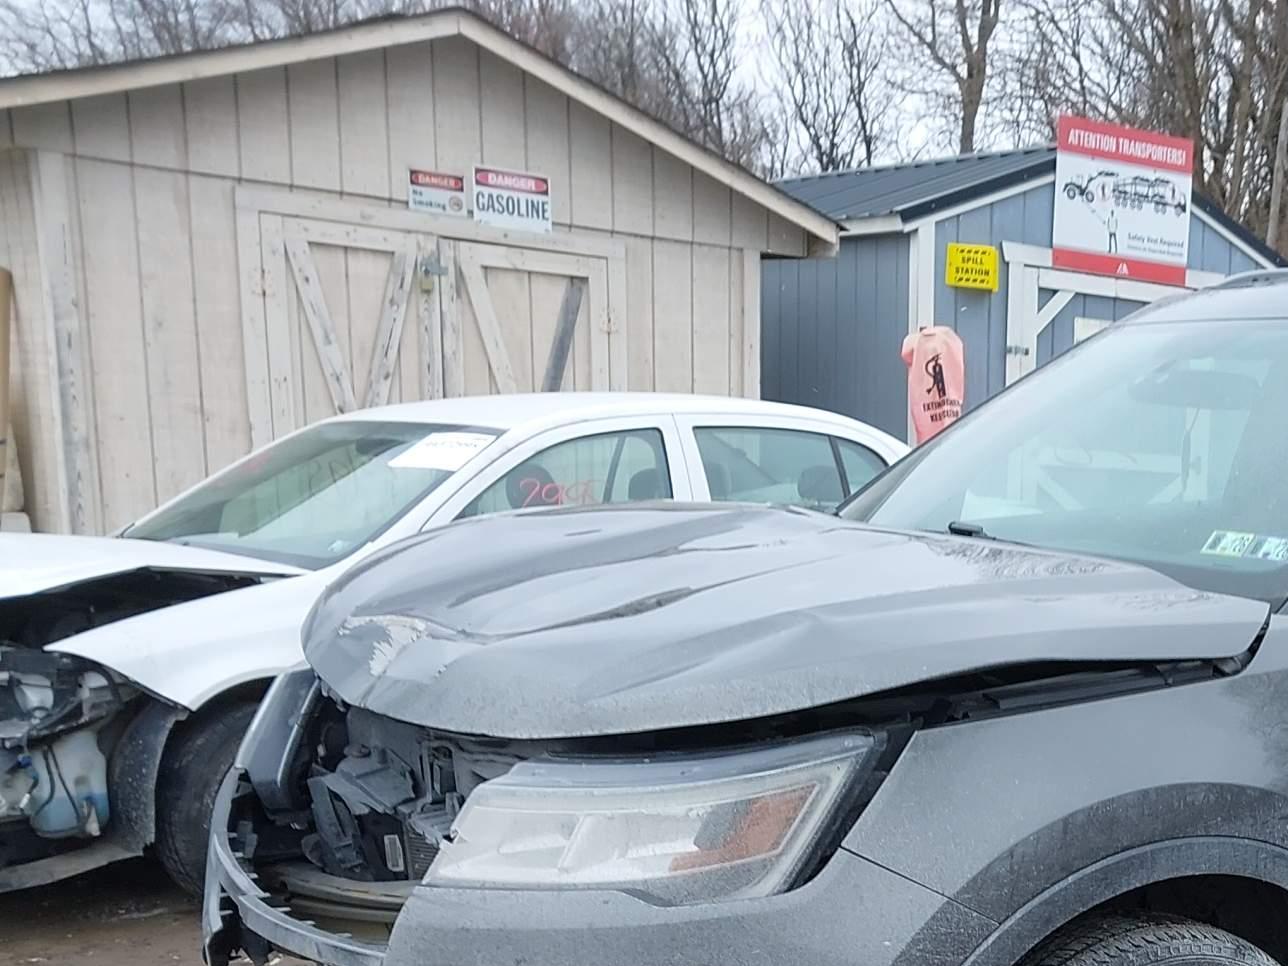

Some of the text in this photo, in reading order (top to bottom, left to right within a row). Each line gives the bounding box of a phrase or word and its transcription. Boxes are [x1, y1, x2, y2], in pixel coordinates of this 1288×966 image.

[1068, 128, 1186, 166] ATTENTION TRANSPORTERS!
[418, 173, 456, 188] DANGER
[487, 172, 536, 190] DANGER
[412, 195, 447, 211] Smoking
[475, 191, 550, 221] GASOLINE
[961, 255, 984, 266] SPILL
[955, 266, 990, 277] STATION
